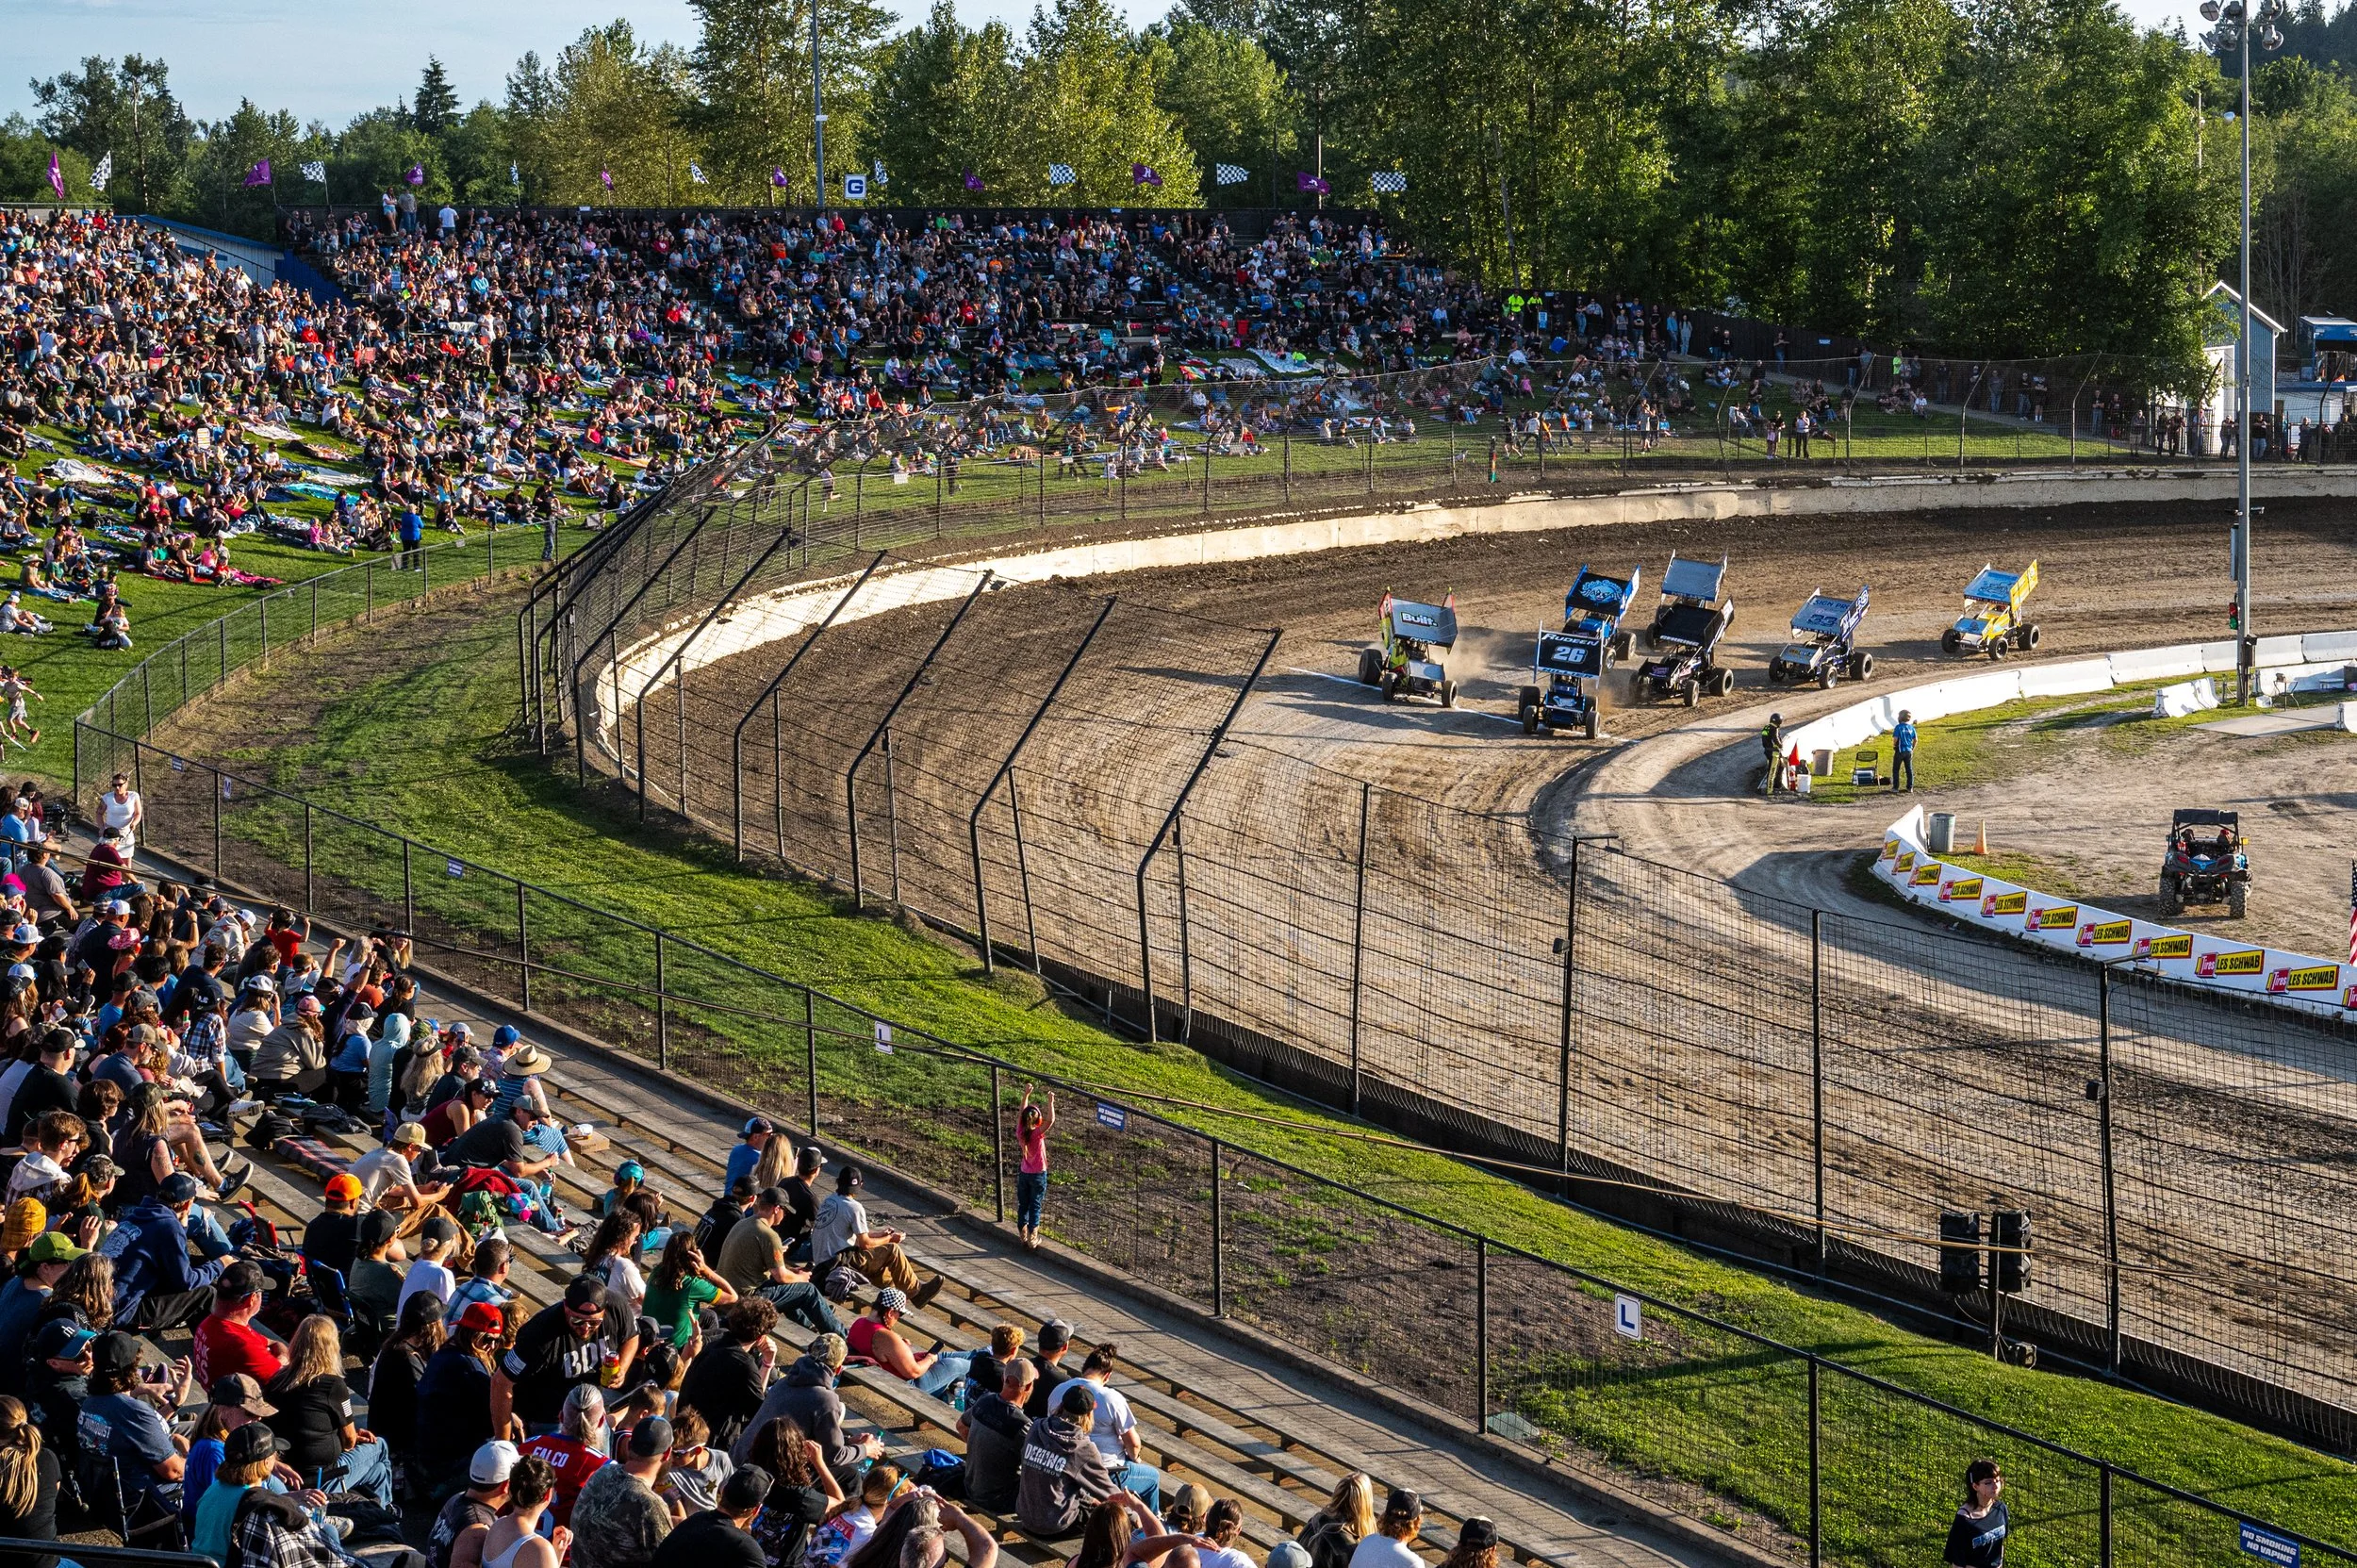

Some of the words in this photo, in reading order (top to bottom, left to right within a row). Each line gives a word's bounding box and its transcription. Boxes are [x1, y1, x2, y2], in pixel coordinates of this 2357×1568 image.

[848, 179, 864, 194] G
[1401, 612, 1438, 627] Built.
[1541, 633, 1600, 647] RUDEEN
[1553, 646, 1588, 664] 26
[2041, 914, 2051, 925] LES
[2050, 911, 2074, 925] SCHWAB
[2093, 928, 2103, 939] LES
[2103, 925, 2129, 939] SCHWAB
[2159, 939, 2189, 954] SCHWAB
[2200, 955, 2216, 976] Tires
[2216, 958, 2228, 970] LES
[2229, 955, 2260, 969] SCHWAB
[2271, 971, 2287, 990] Tires
[2288, 975, 2300, 986] LES
[2301, 970, 2334, 985] SCHWAB
[878, 1028, 889, 1047] L
[1621, 1303, 1635, 1330] L
[532, 1445, 569, 1468] FALCO
[1024, 1443, 1067, 1473] DEMING
[2242, 1530, 2254, 1541] NO
[2255, 1535, 2297, 1556] SMOKING
[2247, 1541, 2259, 1551] NO
[2260, 1546, 2292, 1564] VAPING
